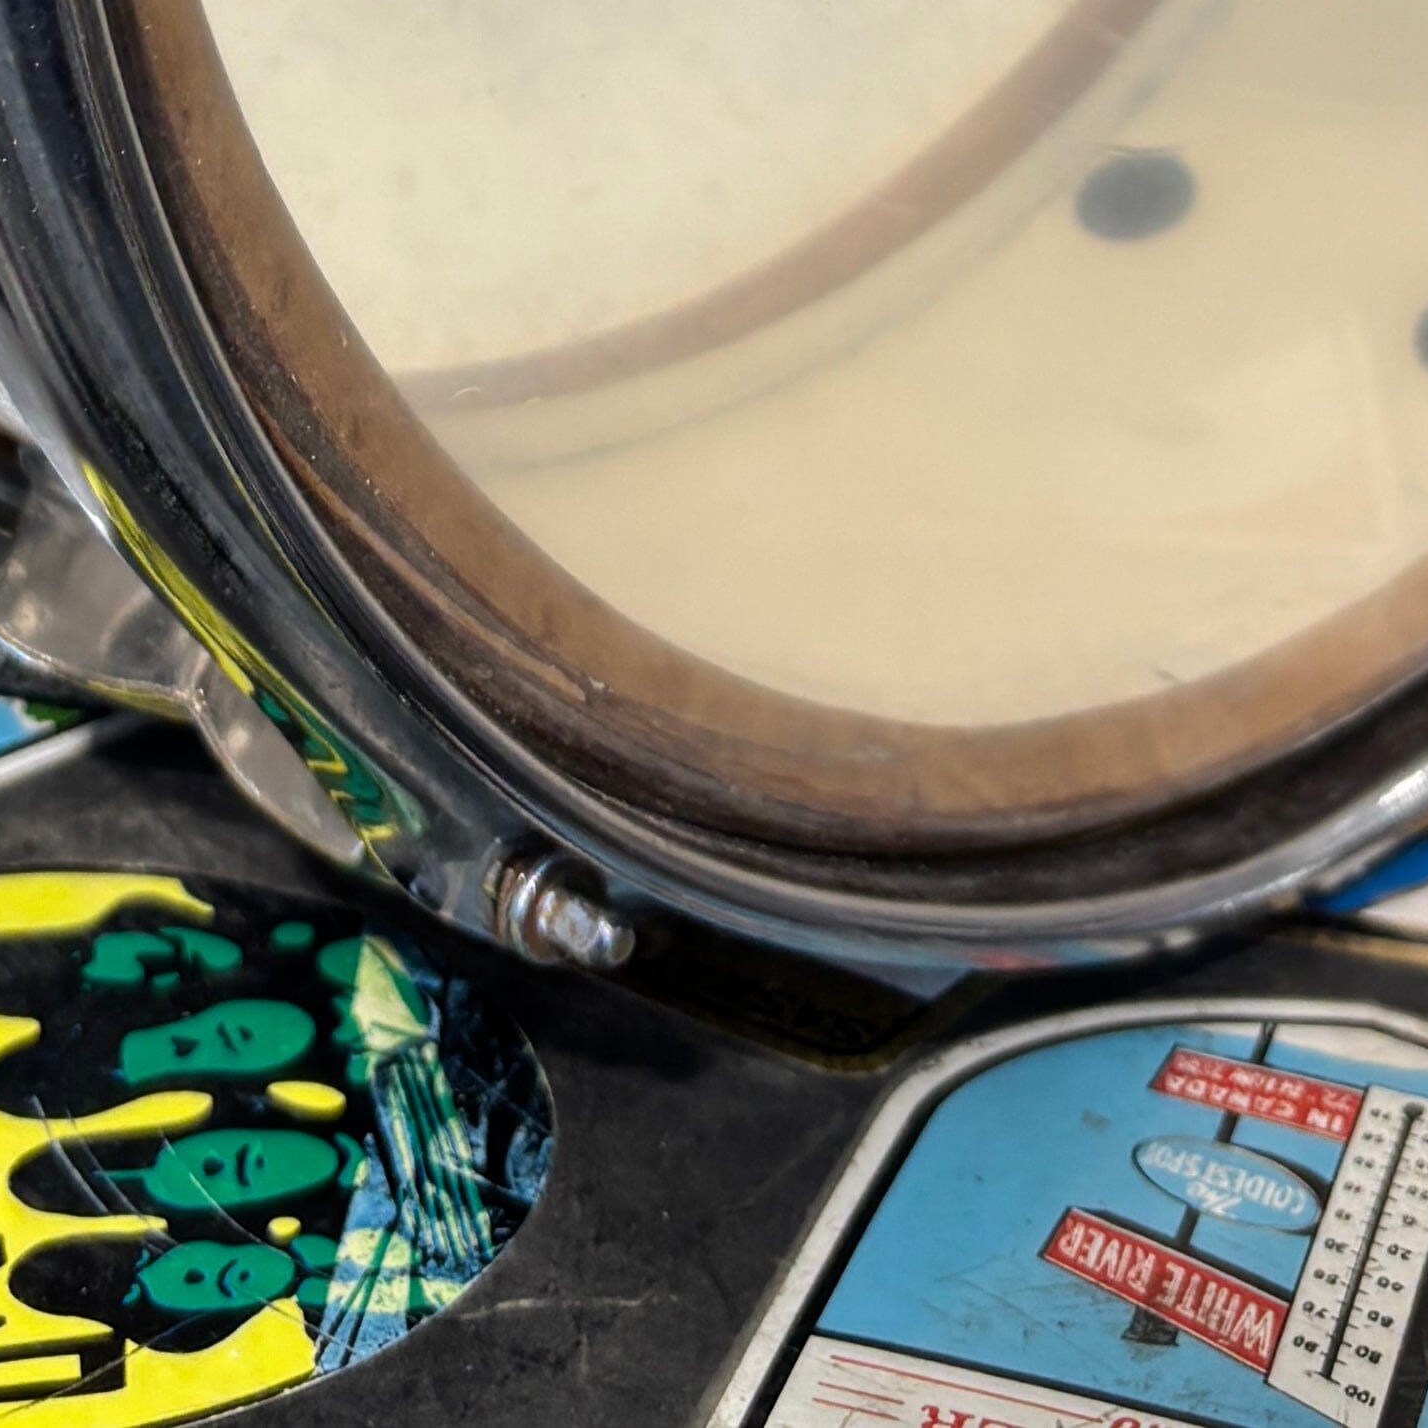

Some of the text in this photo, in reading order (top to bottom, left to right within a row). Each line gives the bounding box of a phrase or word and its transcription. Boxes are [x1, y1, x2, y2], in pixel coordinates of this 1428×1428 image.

[1164, 1072, 1345, 1134] IN CANADA
[1058, 1221, 1277, 1359] WHITE RIVER
